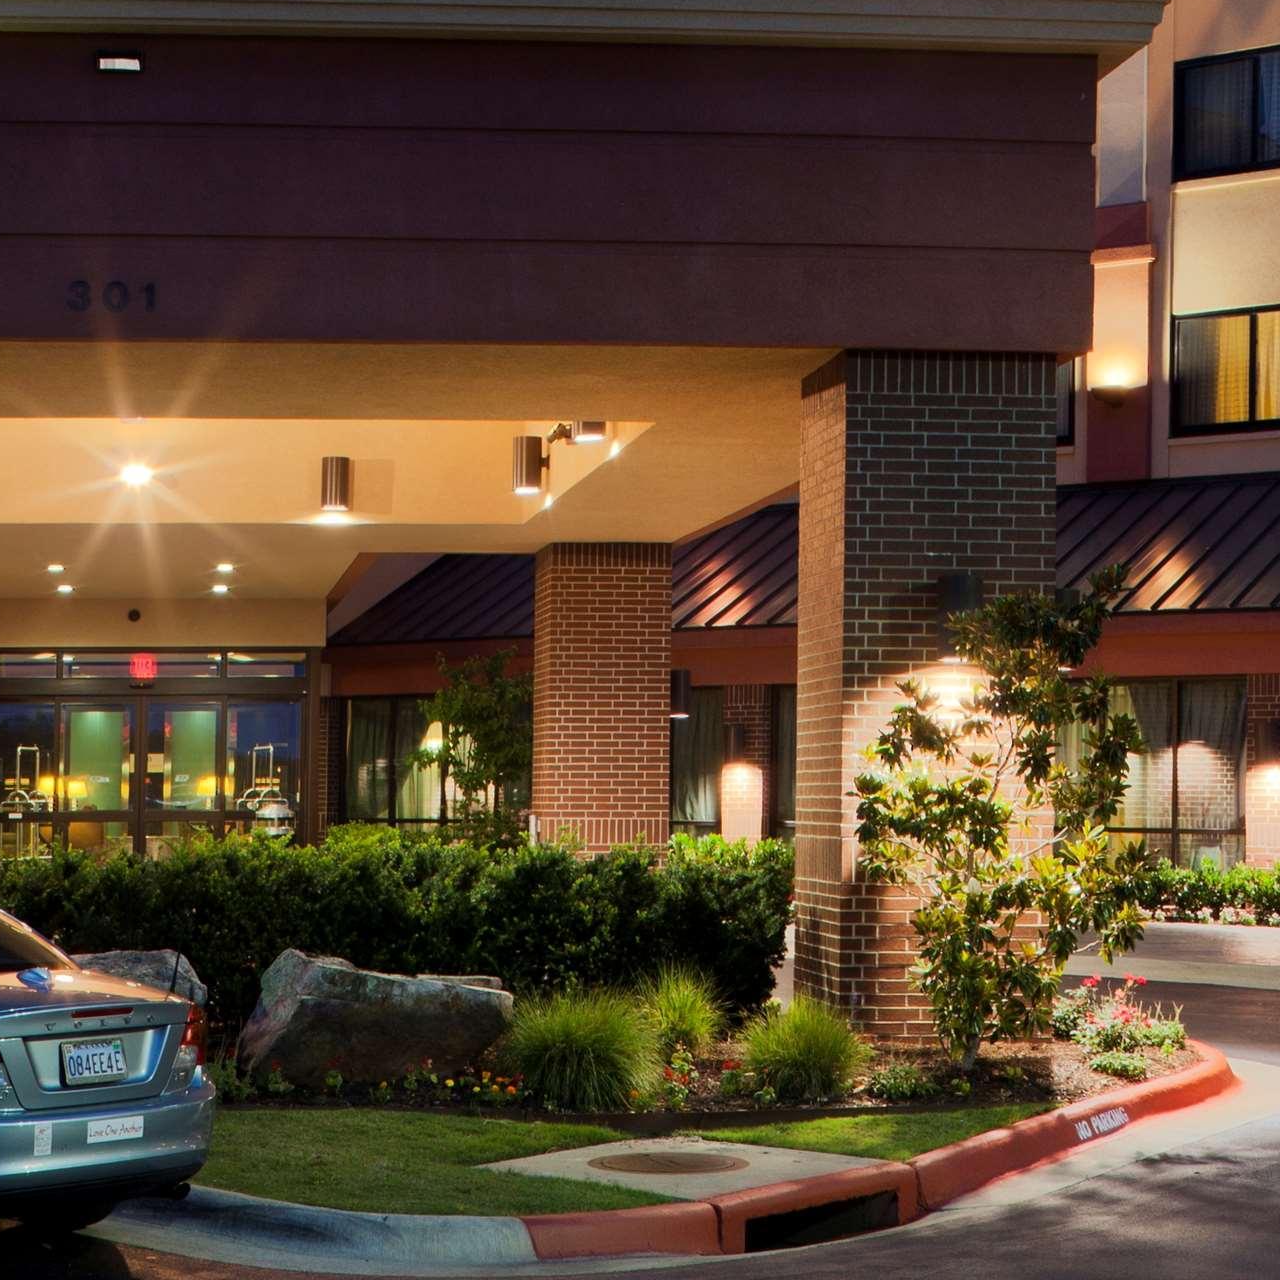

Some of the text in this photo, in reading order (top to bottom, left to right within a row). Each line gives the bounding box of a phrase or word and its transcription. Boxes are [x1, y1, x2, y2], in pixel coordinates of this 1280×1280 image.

[66, 280, 156, 312] 301
[1075, 1106, 1129, 1140] NO PARKING
